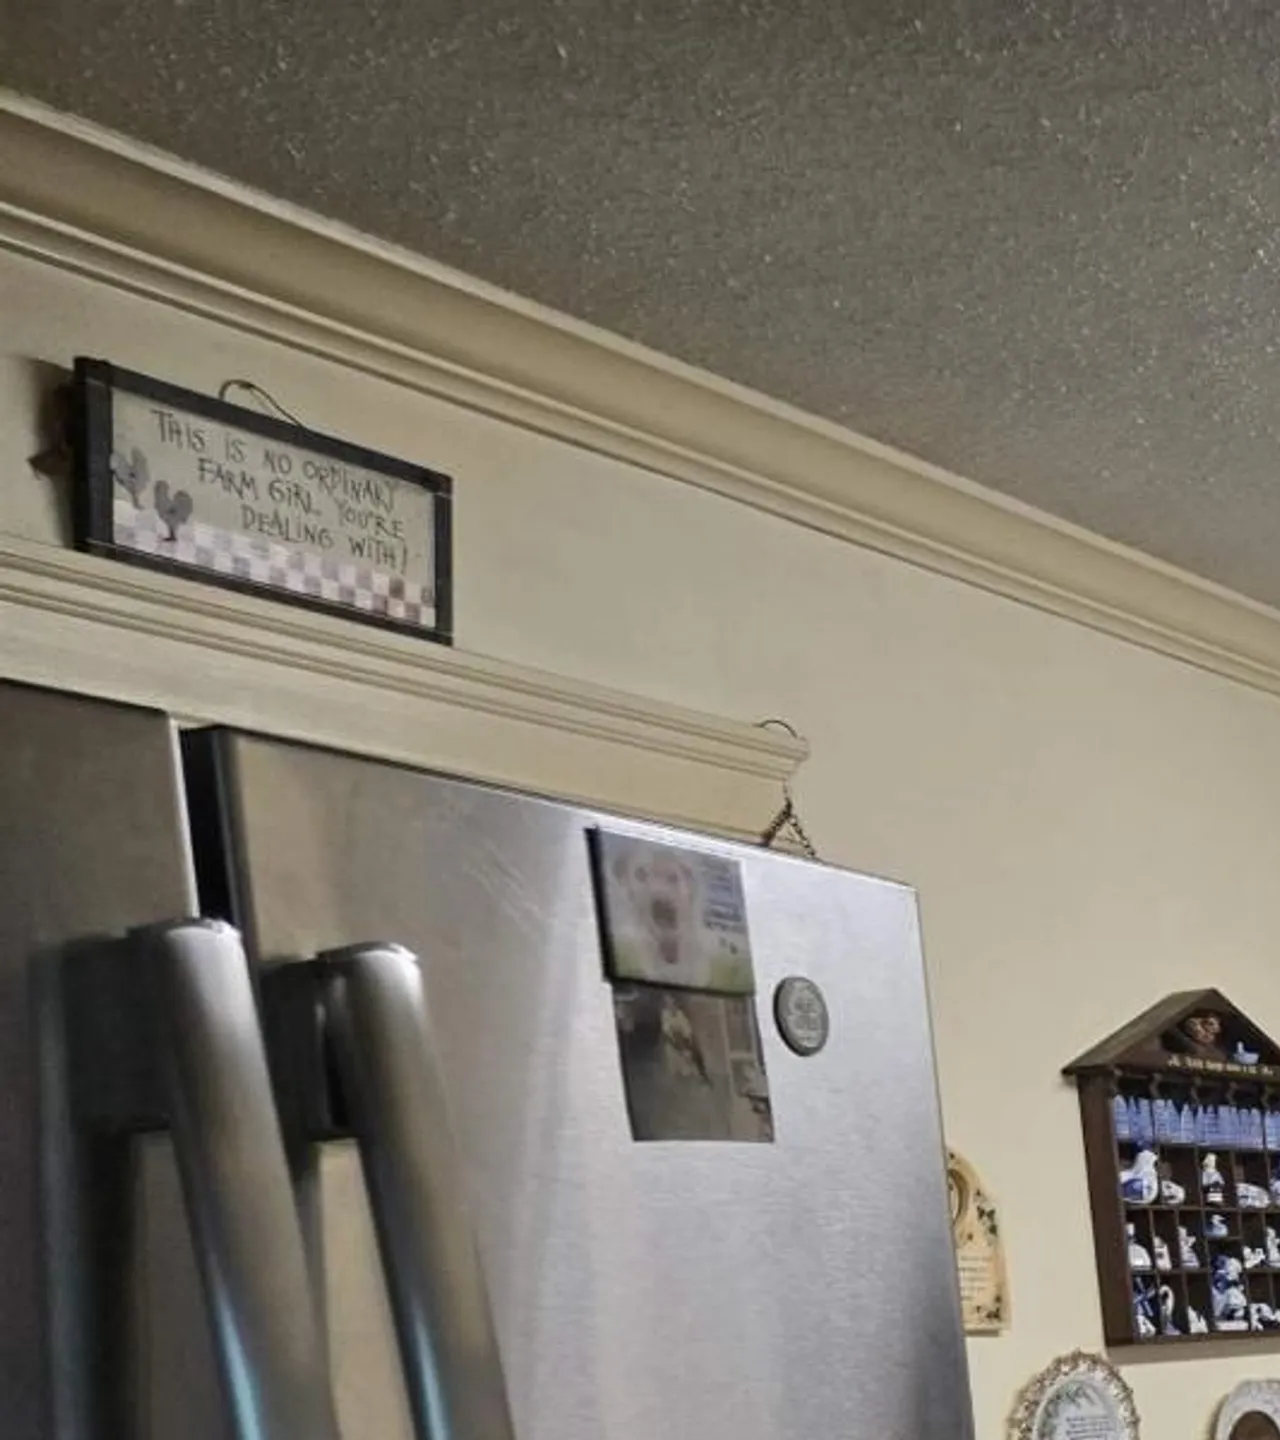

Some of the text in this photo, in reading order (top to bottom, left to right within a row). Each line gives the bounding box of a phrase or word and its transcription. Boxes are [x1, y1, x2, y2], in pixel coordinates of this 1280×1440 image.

[152, 409, 398, 513] THIS IS NO ORDINARY
[197, 458, 258, 500] FARM
[336, 499, 403, 540] YOU'RE
